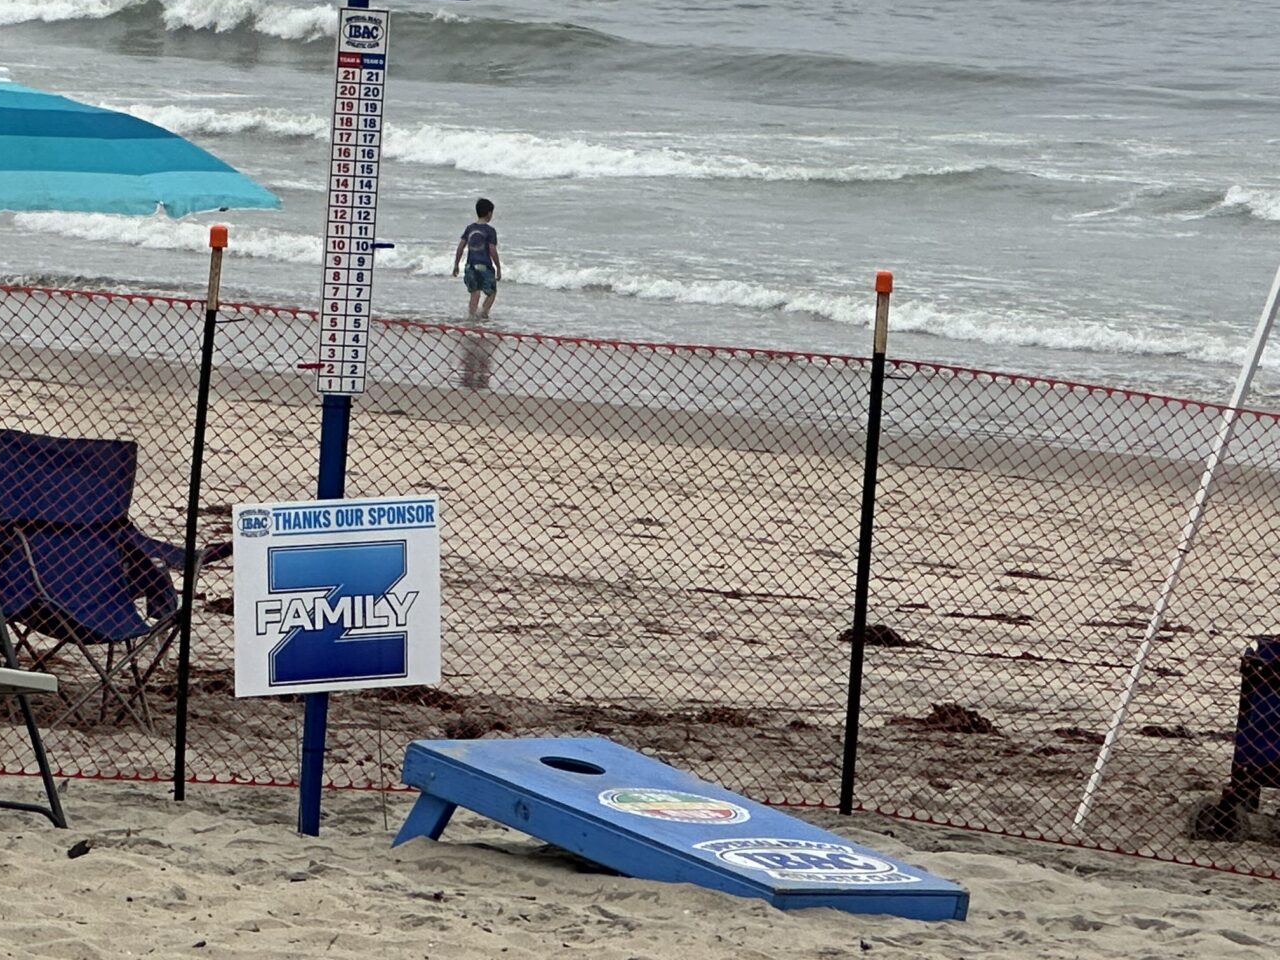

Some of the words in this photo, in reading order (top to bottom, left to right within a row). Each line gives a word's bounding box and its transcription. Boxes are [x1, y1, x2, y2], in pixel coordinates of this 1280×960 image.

[348, 24, 379, 39] IBAC
[342, 70, 356, 81] 21
[366, 71, 379, 82] 21
[340, 85, 356, 96] 20
[363, 86, 380, 98] 20
[341, 101, 354, 112] 19
[364, 102, 377, 113] 19
[340, 117, 353, 127] 18
[363, 118, 376, 129] 18
[339, 132, 352, 142] 17
[363, 133, 376, 144] 17
[338, 147, 351, 158] 16
[361, 148, 374, 159] 16
[337, 163, 350, 173] 15
[360, 164, 373, 175] 15
[336, 178, 349, 189] 14
[359, 179, 372, 190] 14
[335, 193, 348, 204] 13
[358, 195, 371, 205] 13
[334, 209, 347, 220] 12
[357, 210, 370, 221] 12
[335, 225, 344, 235] 11
[358, 226, 368, 236] 11
[332, 240, 345, 250] 10
[356, 241, 369, 252] 10
[333, 255, 342, 266] 9
[357, 256, 365, 267] 9
[332, 271, 341, 281] 8
[356, 272, 364, 283] 8
[332, 286, 340, 297] 7
[356, 287, 363, 298] 7
[330, 302, 339, 312] 6
[354, 303, 362, 313] 6
[330, 317, 338, 328] 5
[353, 318, 361, 329] 5
[328, 333, 337, 343] 4
[352, 334, 360, 344] 4
[328, 348, 336, 359] 3
[351, 349, 359, 359] 3
[326, 363, 335, 374] 2
[350, 364, 358, 375] 2
[328, 379, 332, 389] 1
[351, 380, 356, 390] 1
[242, 517, 268, 529] IBAC
[273, 510, 331, 531] THANKS
[336, 508, 364, 527] OUR
[368, 504, 435, 525] SPONSOR
[256, 591, 419, 635] FAMILY
[737, 852, 875, 870] IBAC
